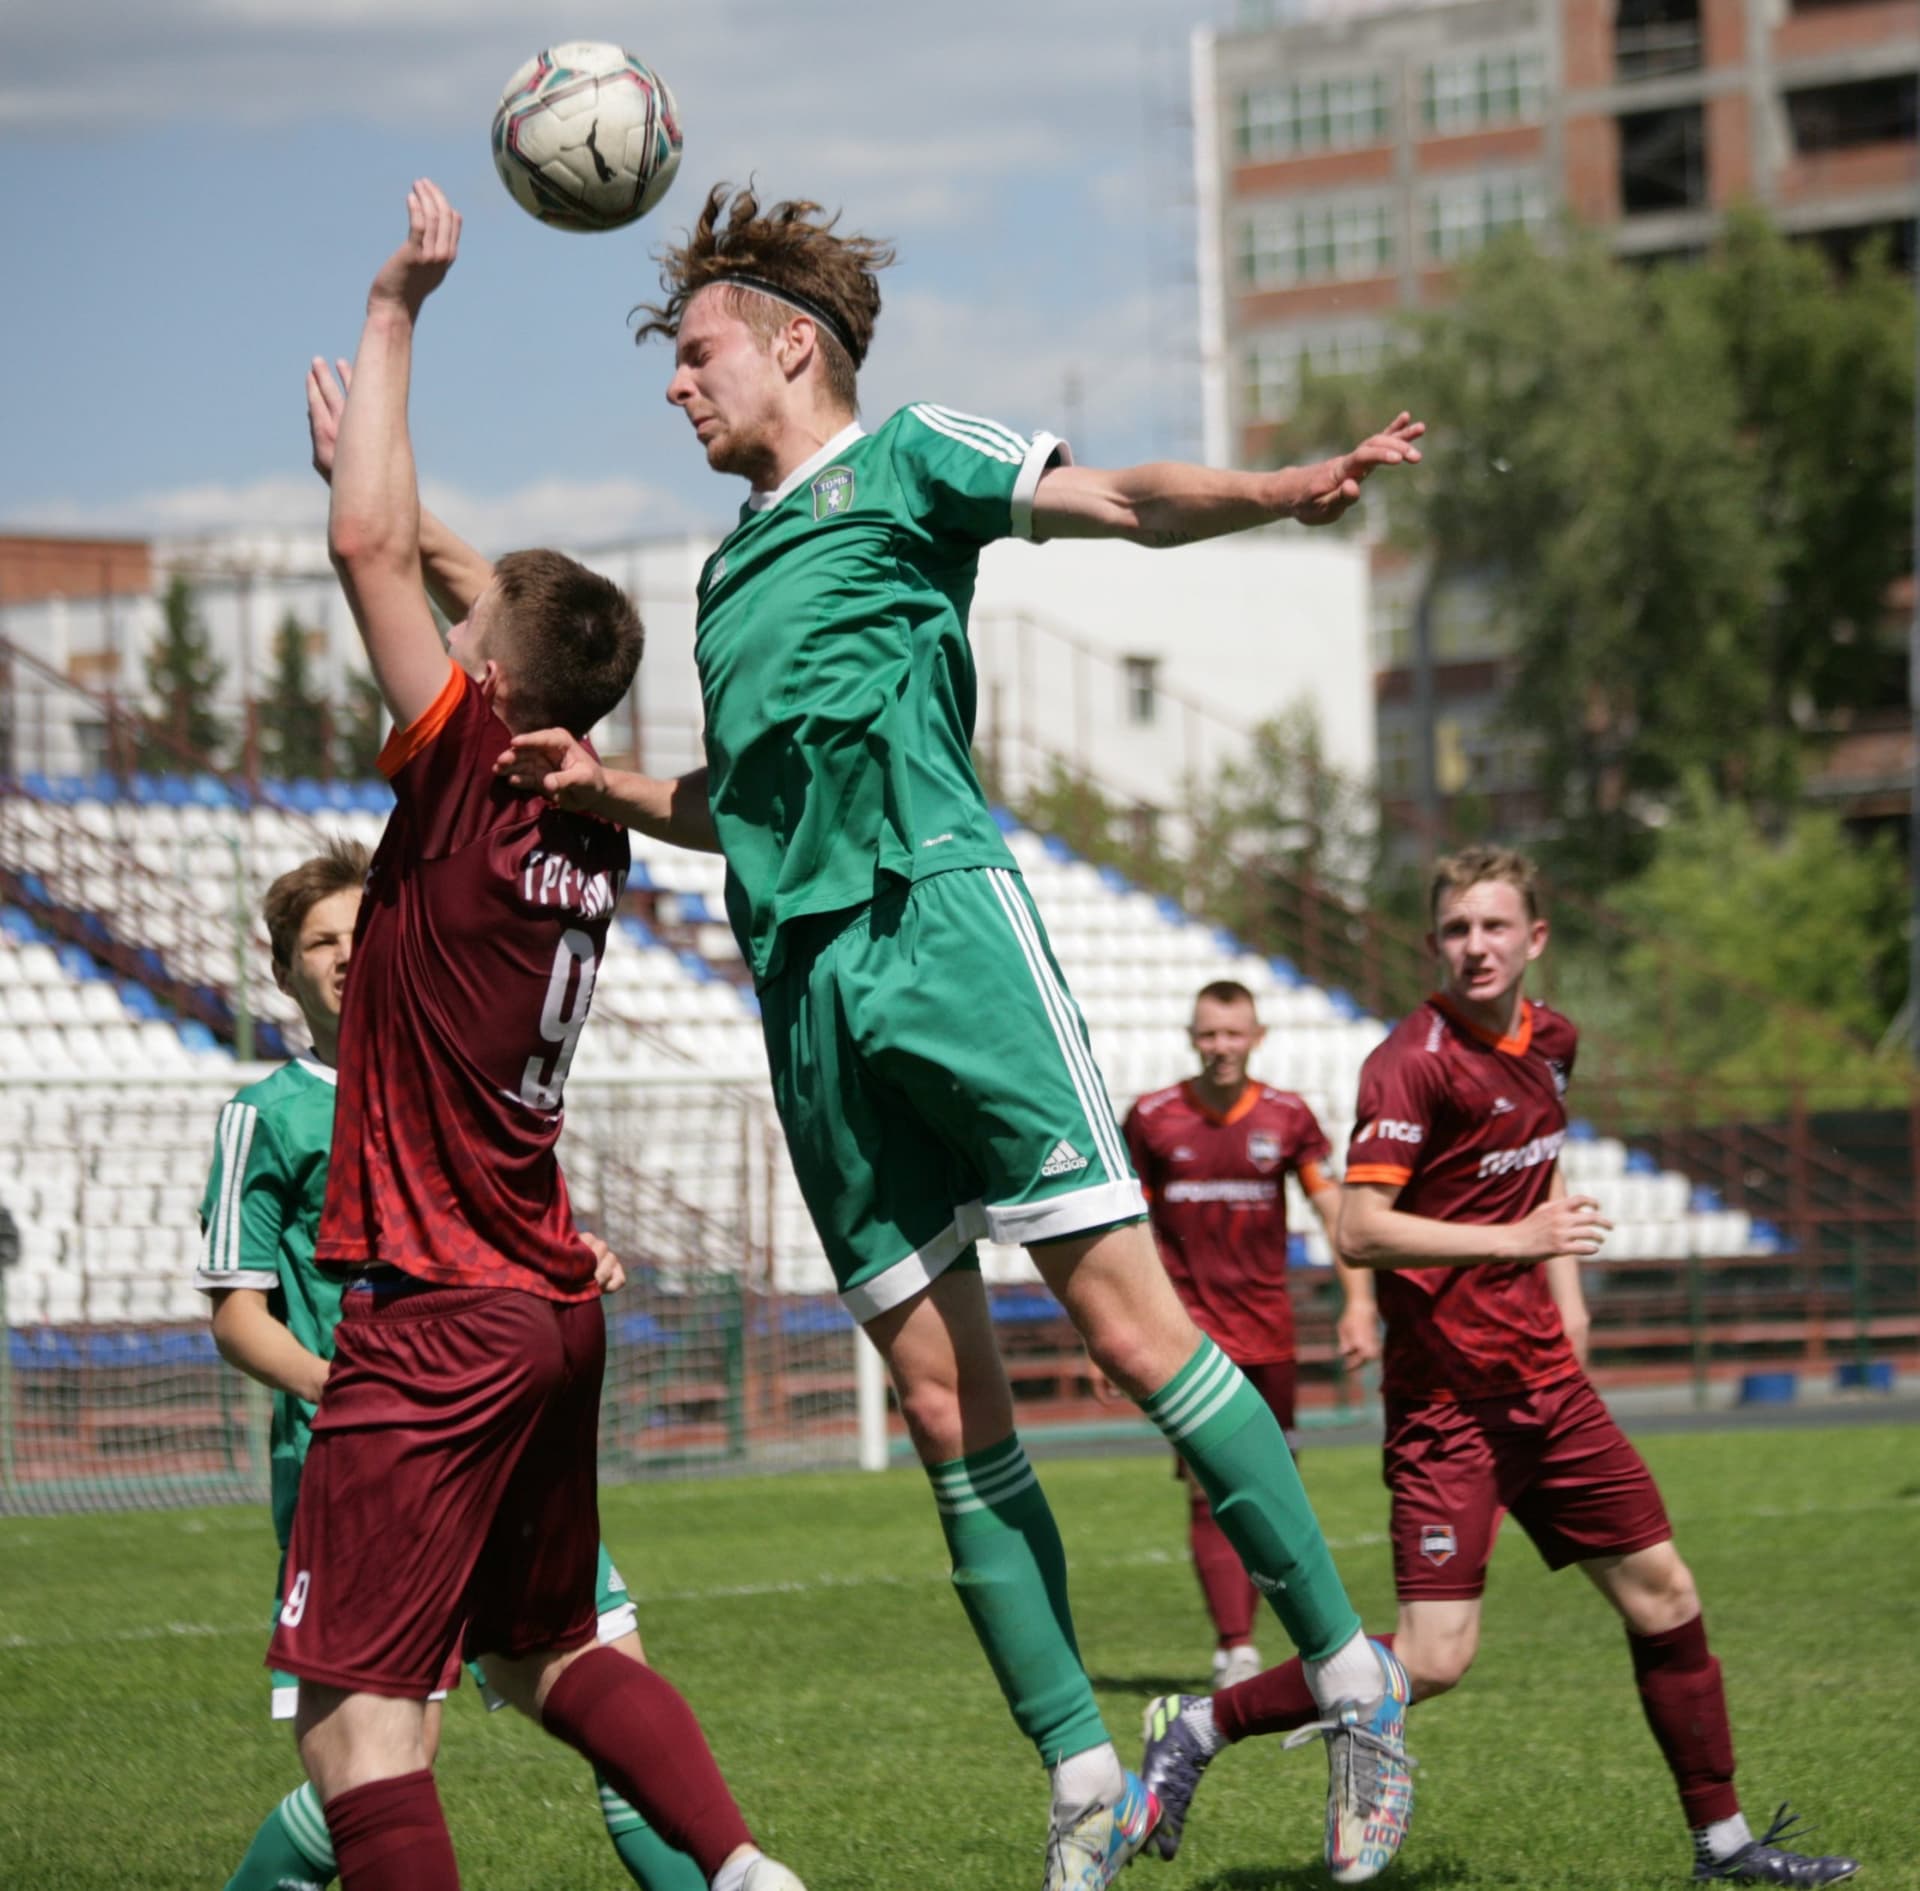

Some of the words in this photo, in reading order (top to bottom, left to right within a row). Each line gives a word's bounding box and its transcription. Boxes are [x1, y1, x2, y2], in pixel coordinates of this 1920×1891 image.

[519, 928, 597, 1110] 9
[1041, 1156, 1088, 1177] adidas
[280, 1570, 311, 1628] 9
